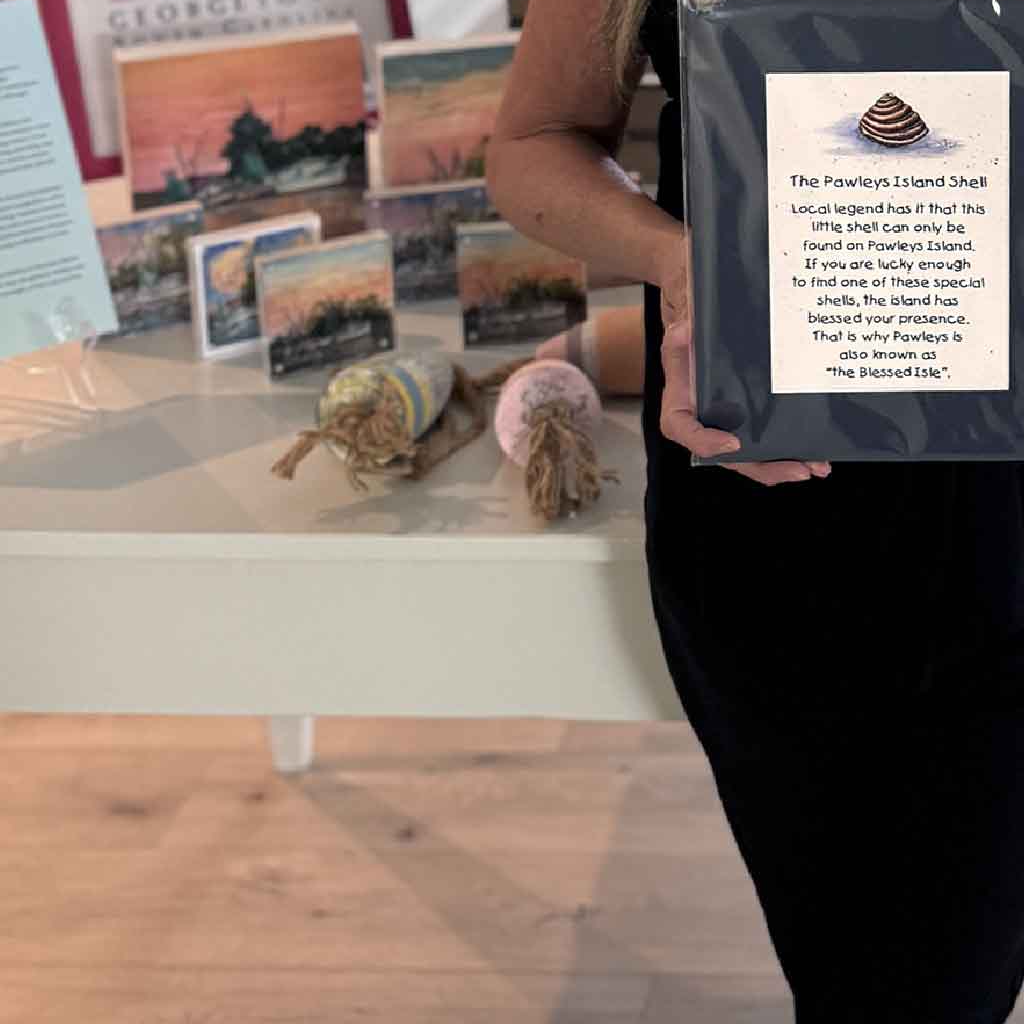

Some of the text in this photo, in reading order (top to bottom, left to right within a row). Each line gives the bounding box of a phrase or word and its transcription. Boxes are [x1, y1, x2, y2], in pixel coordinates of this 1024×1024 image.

[789, 174, 988, 191] The Pawleys Island Shell
[791, 201, 986, 217] Local legend has it that this
[811, 220, 966, 236] little shell can only be
[803, 239, 976, 253] found on Pawleys Island.
[804, 257, 971, 275] If you are lucky enough
[791, 275, 985, 290] to find one of these special
[816, 293, 959, 308] shells, the island has
[807, 311, 971, 326] blessed your presence.
[812, 329, 963, 345] That is why Pawleys is
[839, 349, 937, 361] also known as
[825, 365, 951, 380] "the Blessed Isle".
